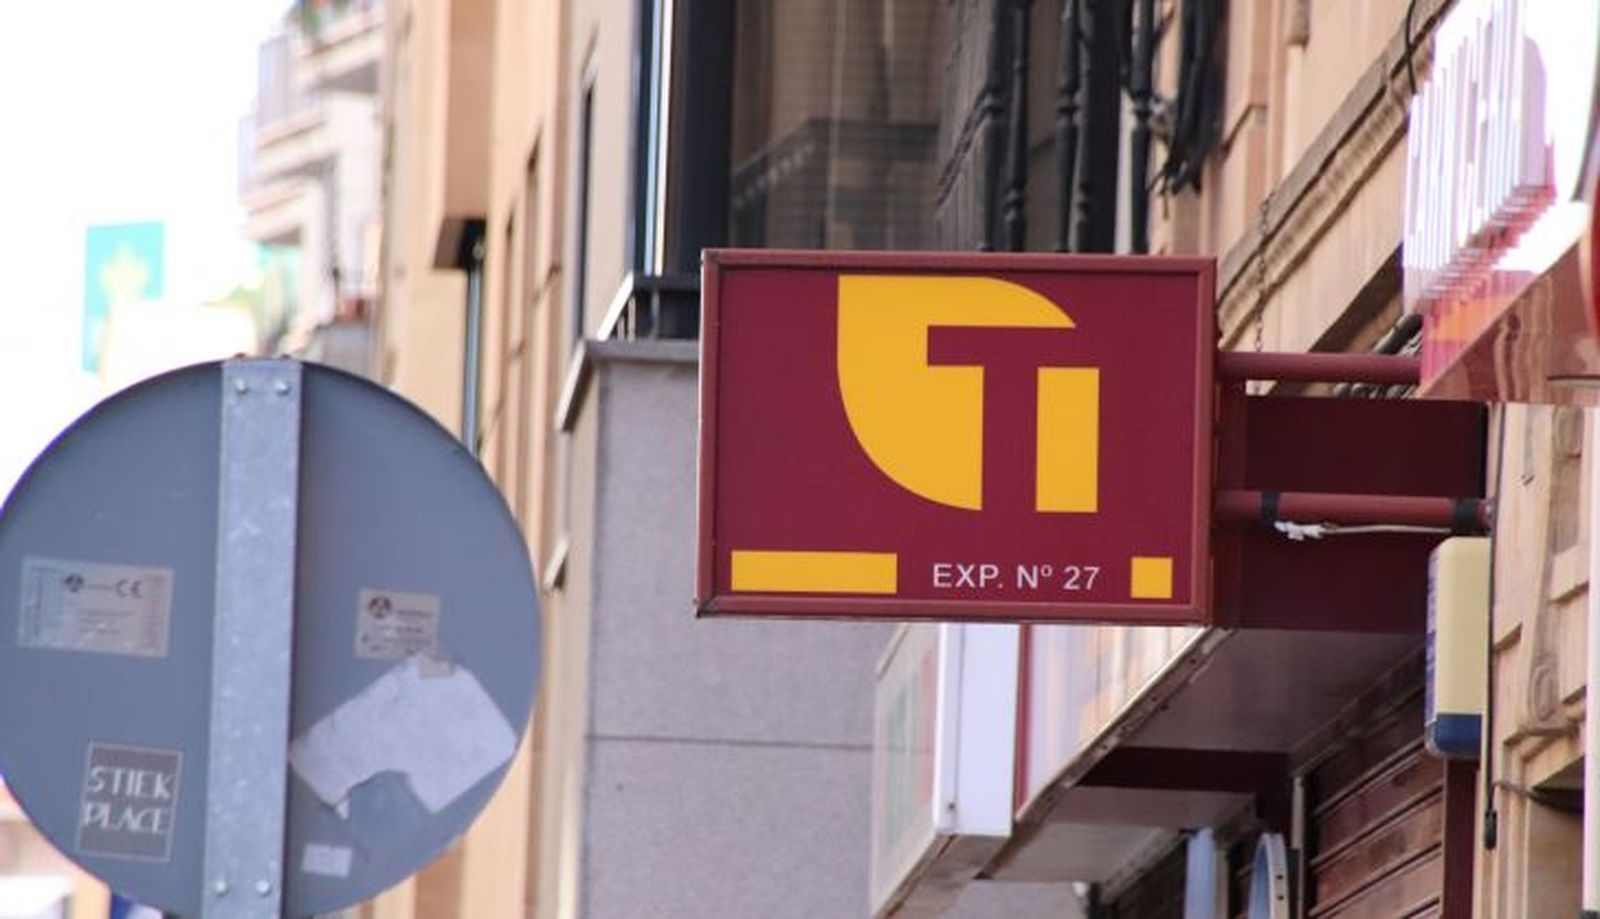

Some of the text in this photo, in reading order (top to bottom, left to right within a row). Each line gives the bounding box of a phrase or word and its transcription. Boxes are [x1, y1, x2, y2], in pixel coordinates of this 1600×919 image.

[932, 563, 1004, 589] EXP.
[1063, 565, 1100, 591] 27
[84, 801, 170, 835] PLACE
